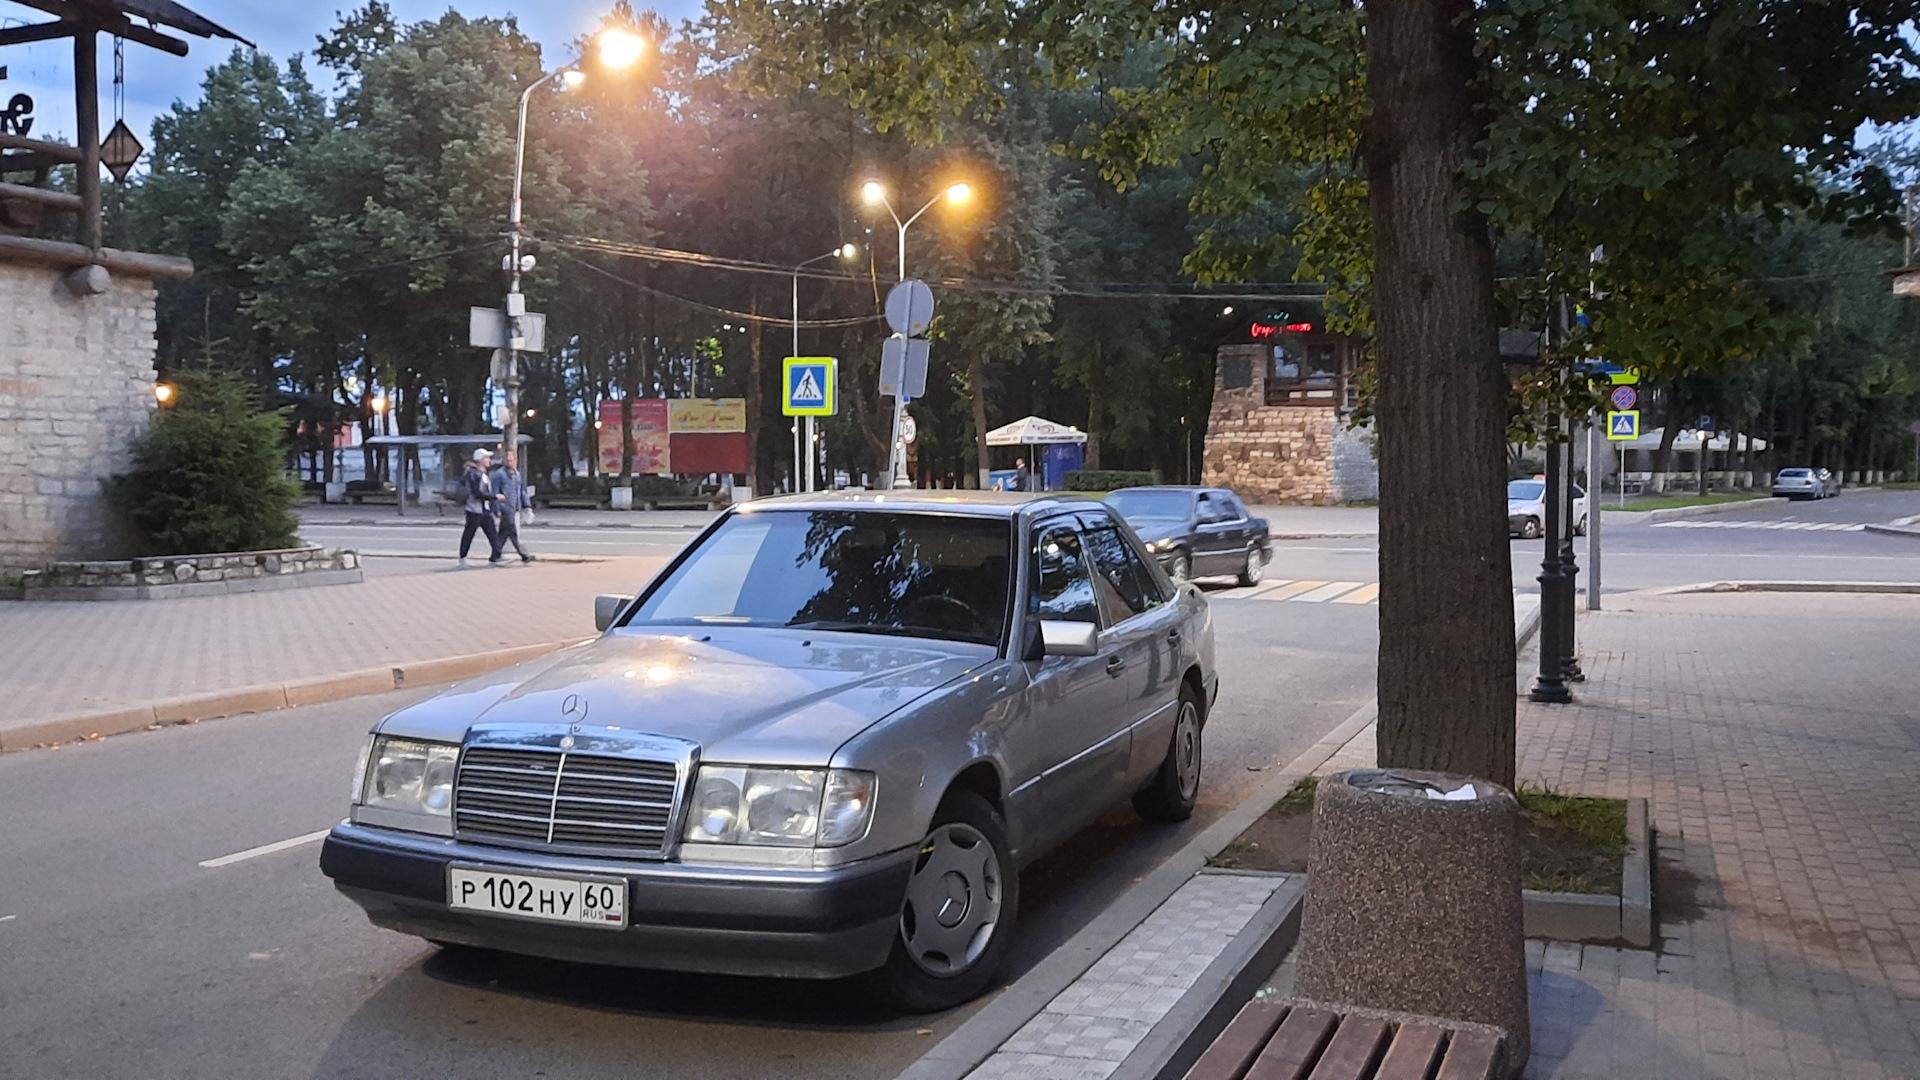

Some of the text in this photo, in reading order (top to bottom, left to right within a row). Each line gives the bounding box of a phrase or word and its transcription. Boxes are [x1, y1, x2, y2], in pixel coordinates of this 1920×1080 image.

[1701, 415, 1711, 428] P
[584, 885, 614, 910] 60
[583, 910, 604, 920] RUS
